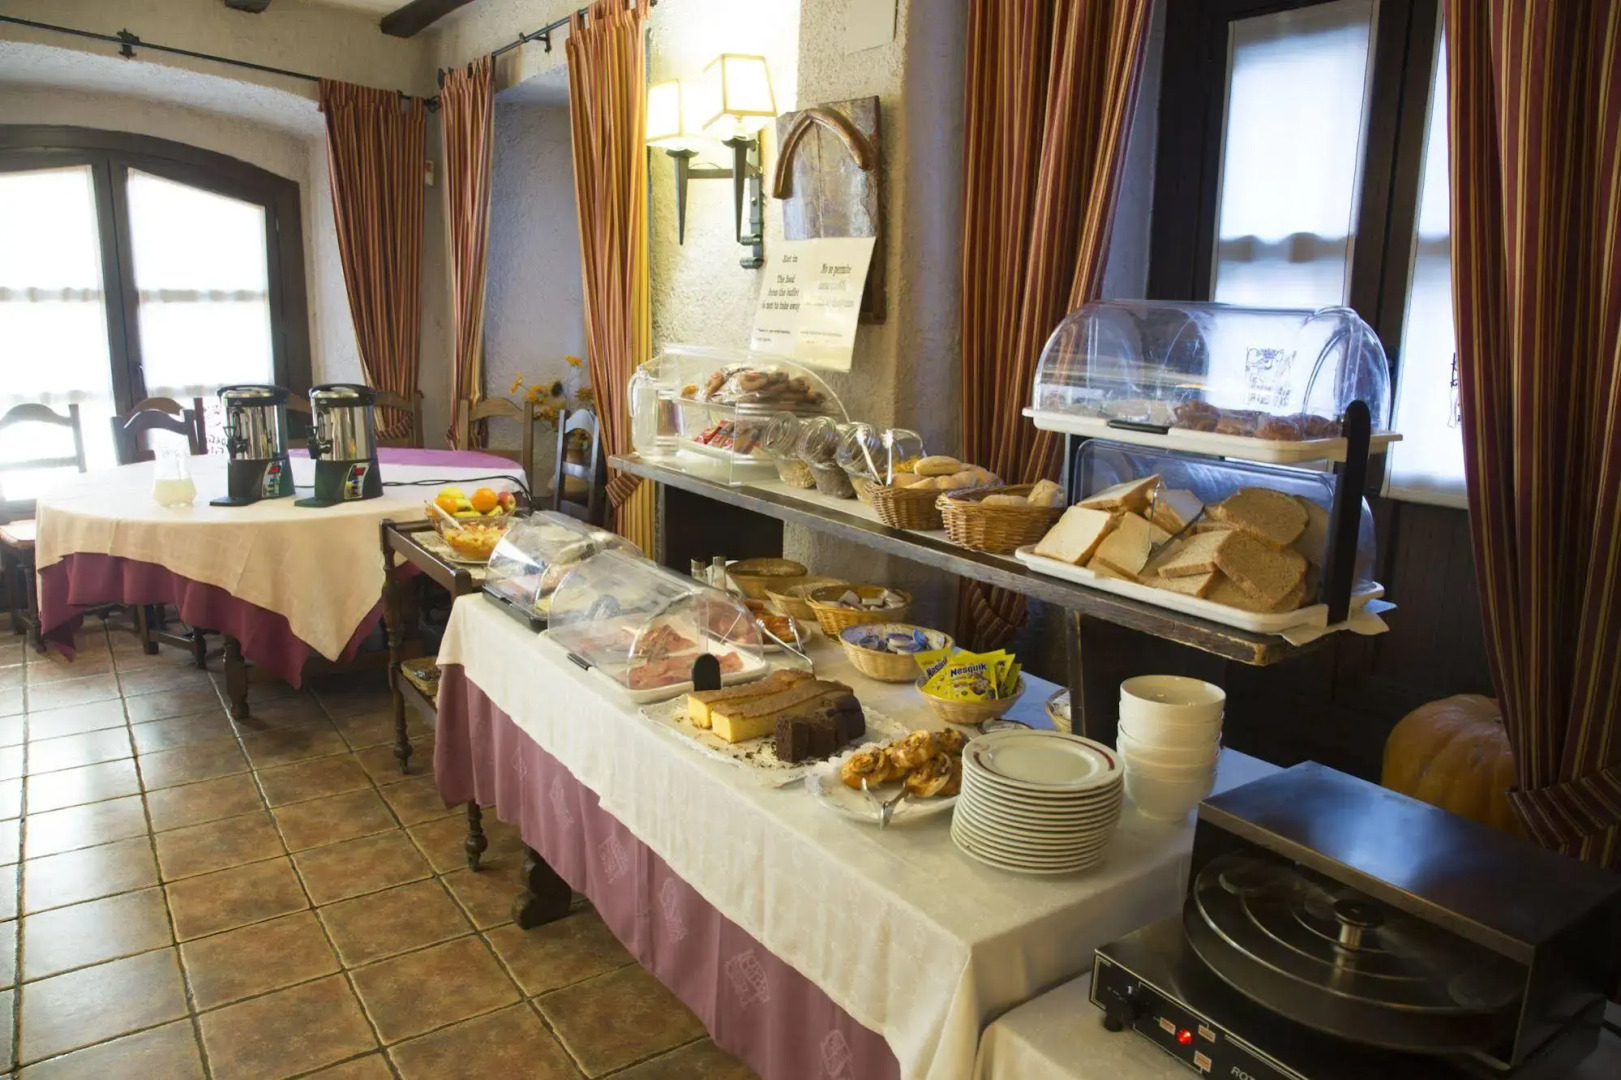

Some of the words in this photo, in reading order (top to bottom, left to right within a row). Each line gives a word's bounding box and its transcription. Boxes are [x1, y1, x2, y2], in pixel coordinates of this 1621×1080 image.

[777, 274, 785, 283] The
[785, 274, 796, 283] food
[778, 287, 786, 296] the
[950, 663, 987, 677] Nesquik
